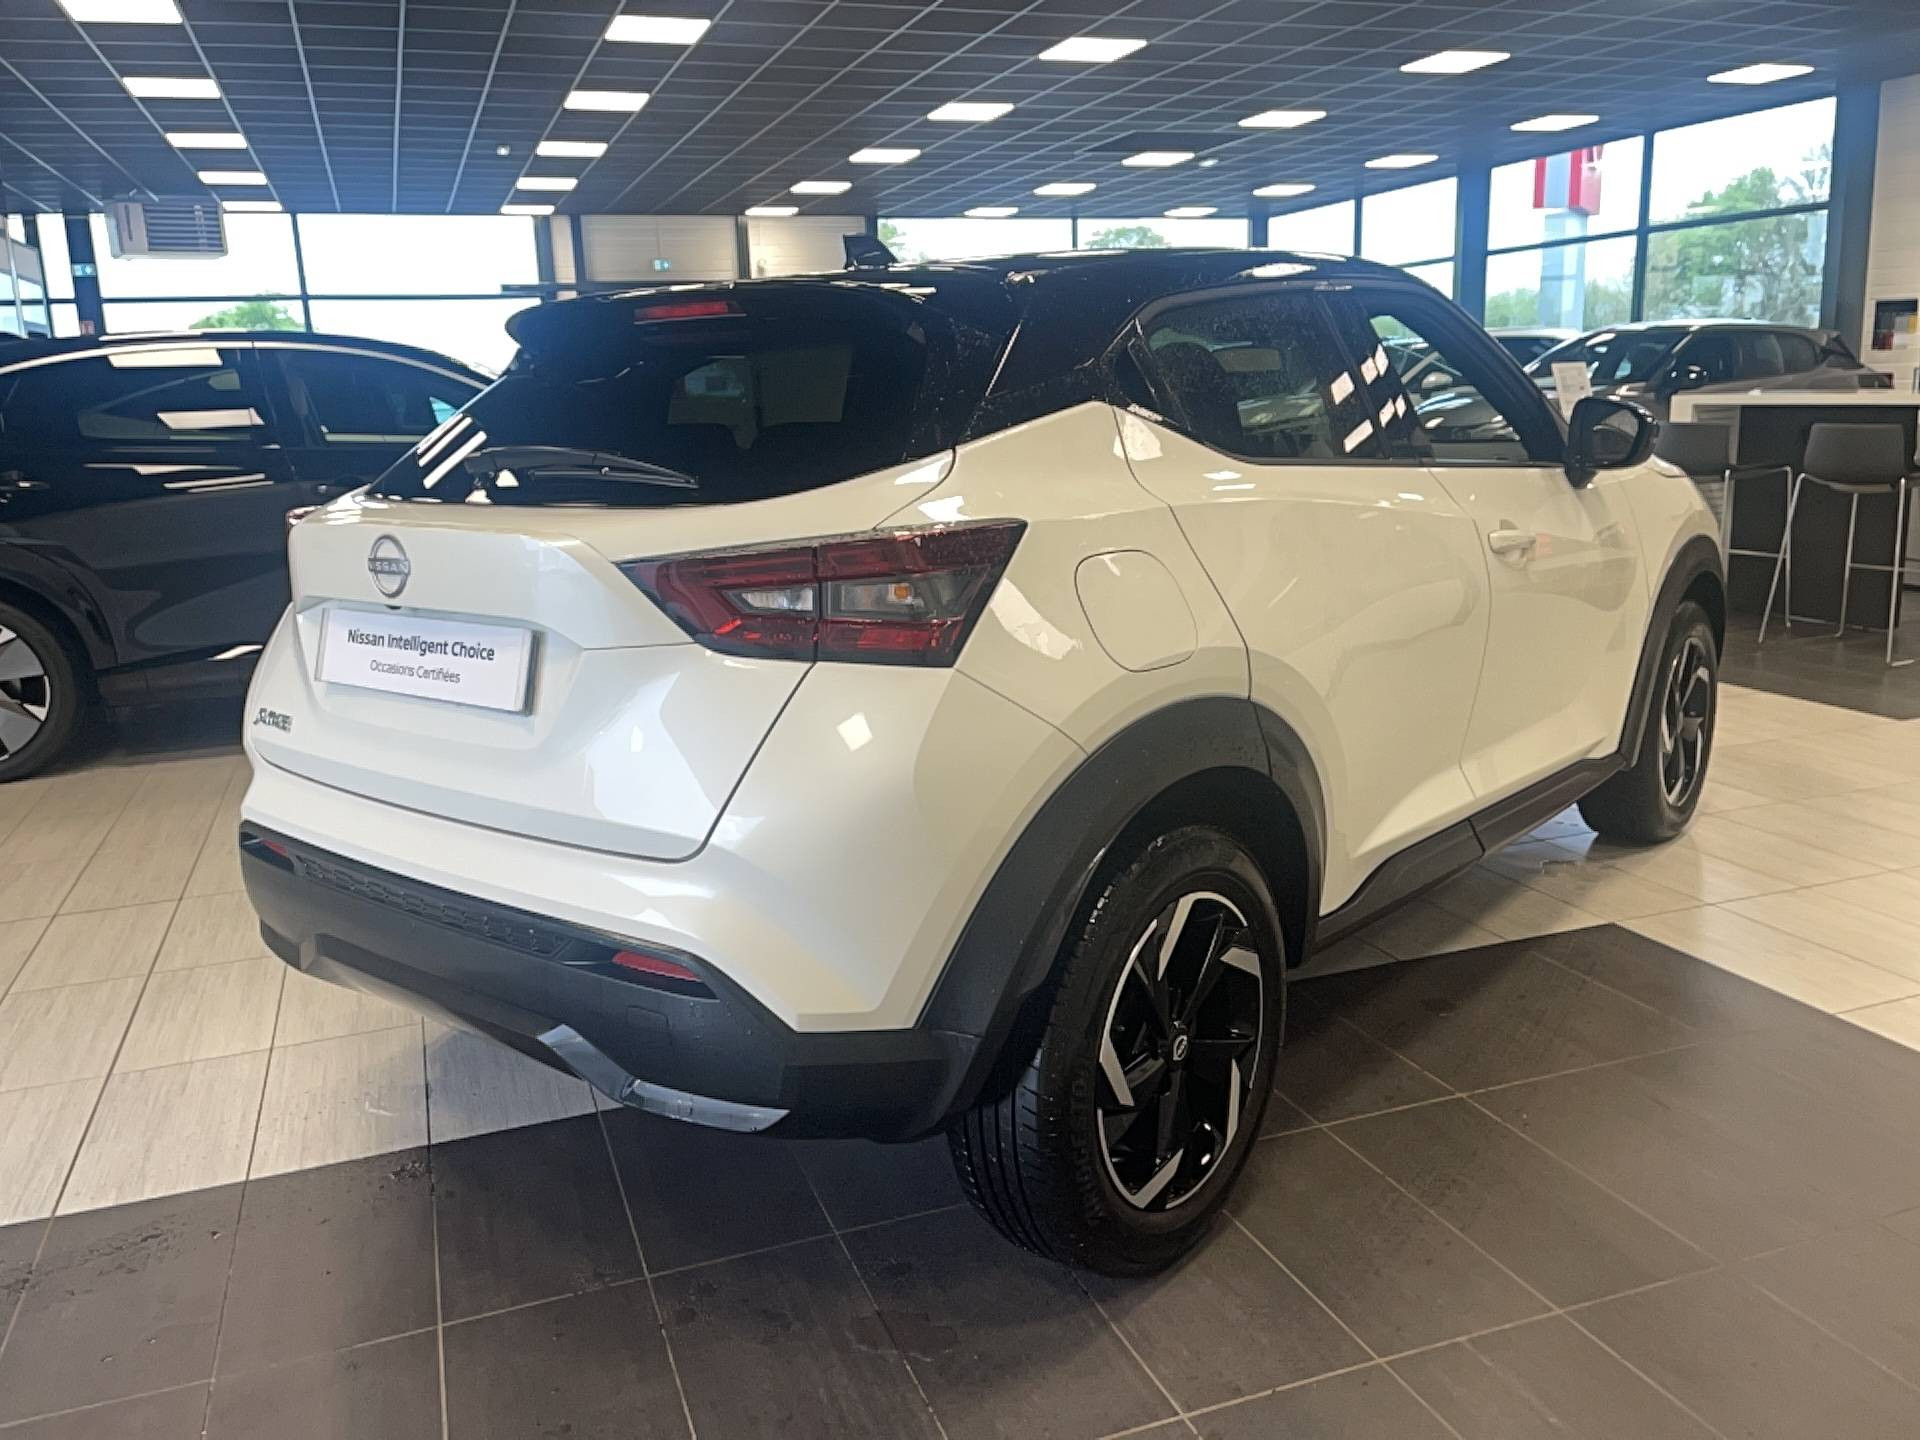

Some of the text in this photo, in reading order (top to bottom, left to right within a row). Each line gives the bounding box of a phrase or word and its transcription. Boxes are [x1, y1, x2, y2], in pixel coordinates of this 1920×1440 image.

[368, 559, 410, 574] NSSAN
[347, 628, 495, 661] Nissan Intelligent Choice
[370, 659, 414, 677] Occasions
